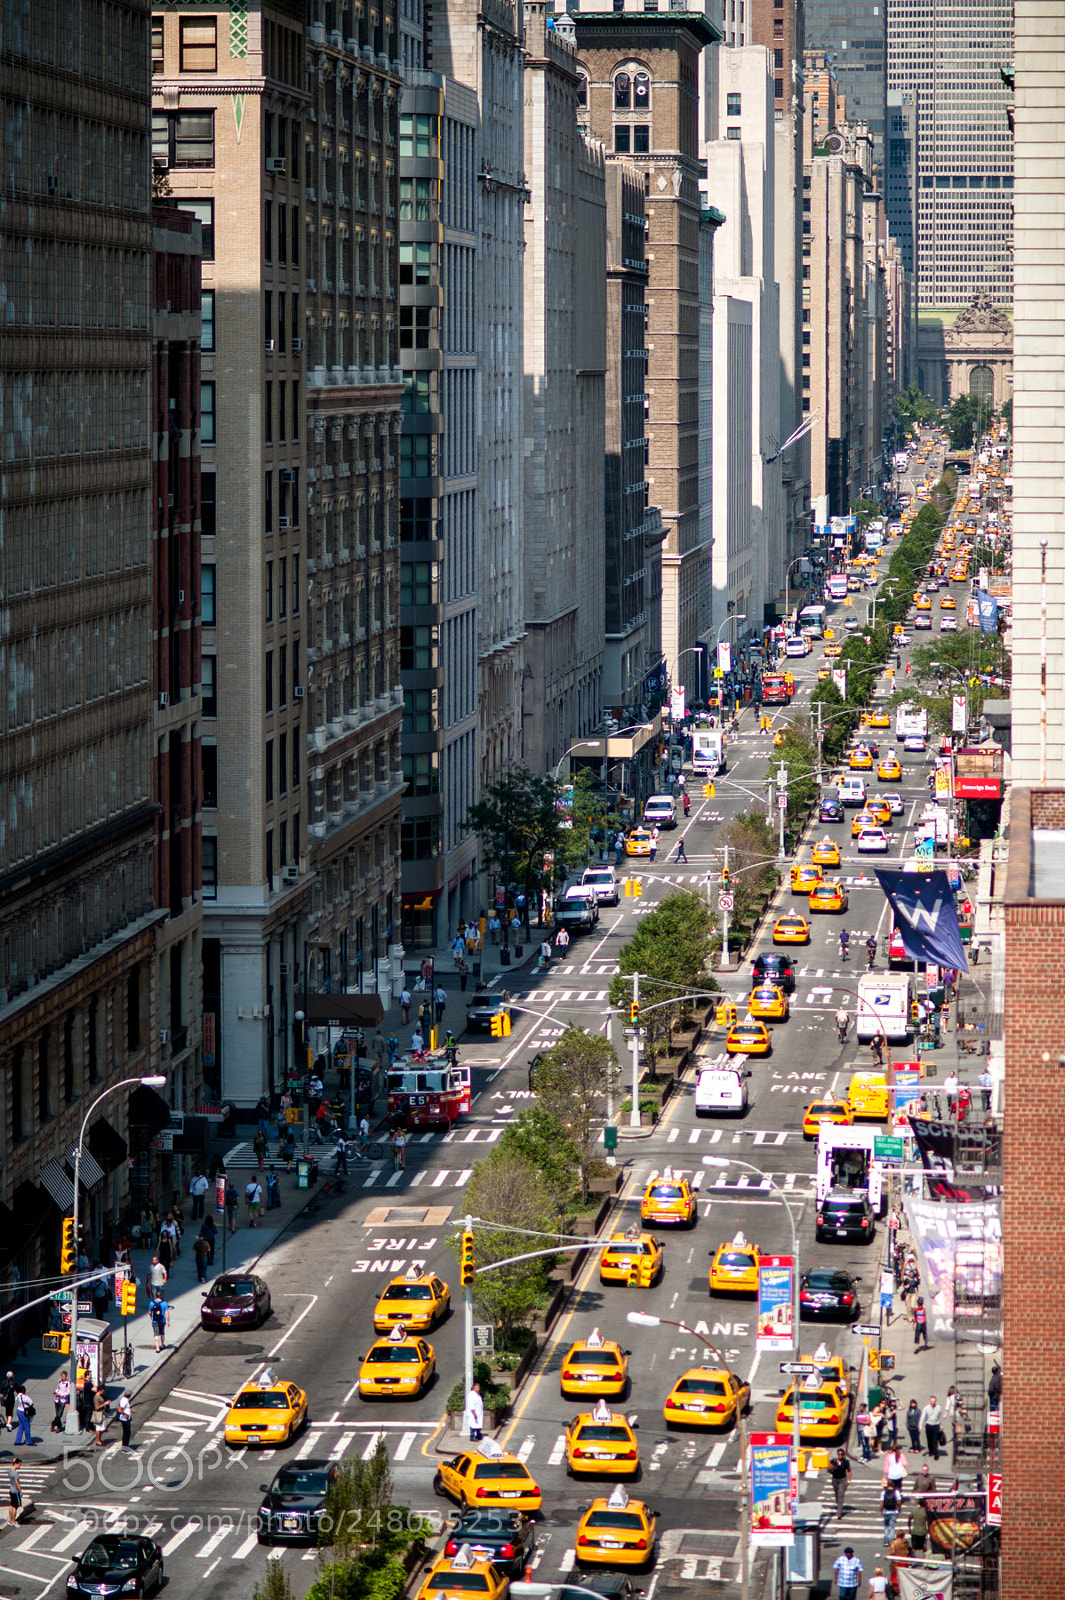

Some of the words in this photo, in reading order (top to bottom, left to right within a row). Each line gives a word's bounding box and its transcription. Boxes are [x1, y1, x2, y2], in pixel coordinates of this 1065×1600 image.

[895, 898, 943, 932] W
[771, 1071, 828, 1080] LANE
[770, 1084, 824, 1094] FIRE
[915, 1121, 992, 1145] SCHOOL
[367, 1238, 438, 1251] FIRE
[679, 1320, 750, 1336] LANE
[668, 1346, 741, 1362] FIRE
[927, 1498, 976, 1512] PIZZA
